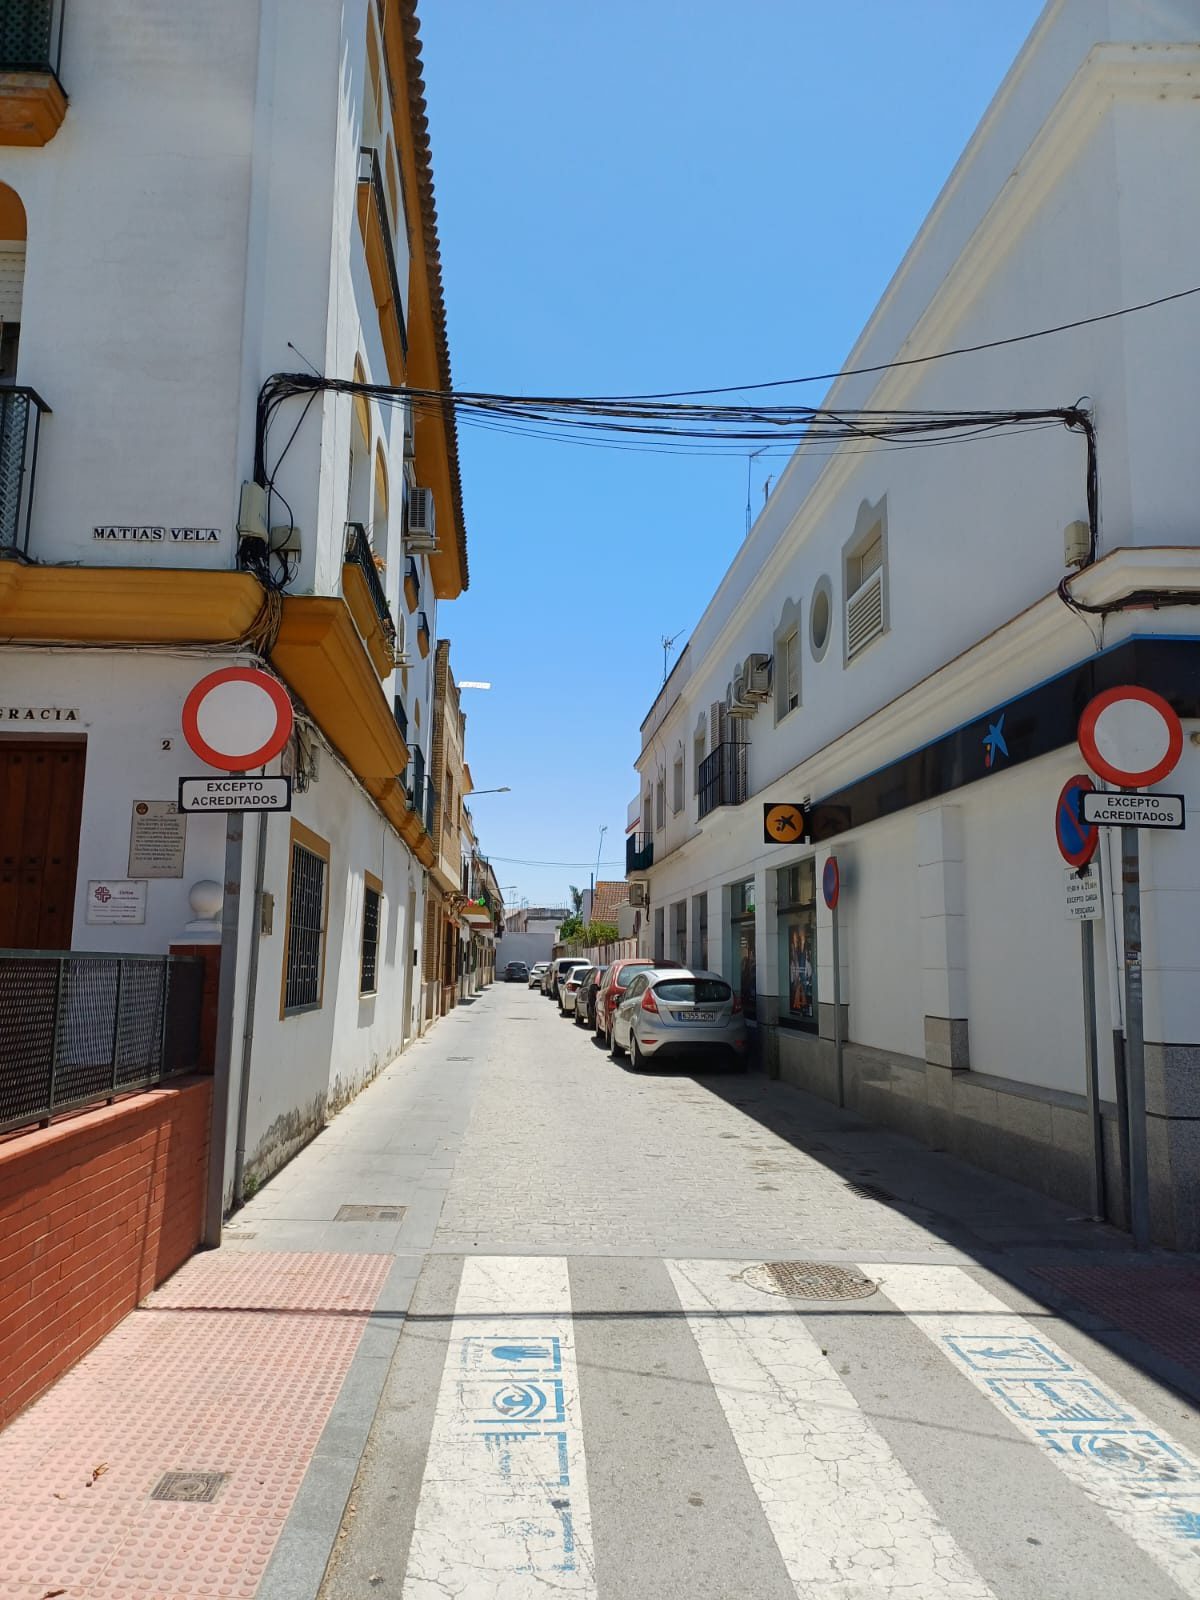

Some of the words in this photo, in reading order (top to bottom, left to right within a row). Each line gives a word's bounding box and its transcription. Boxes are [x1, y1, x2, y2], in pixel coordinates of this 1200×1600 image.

[93, 528, 163, 539] MATIAS
[171, 529, 219, 541] VELA
[162, 740, 171, 750] 2
[207, 782, 263, 792] EXCEPTO
[192, 795, 278, 806] ACREDITADOS
[1107, 797, 1160, 808] EXCEPTO
[1094, 810, 1174, 822] ACREDITADOS
[1066, 896, 1084, 904] EXCEPTO
